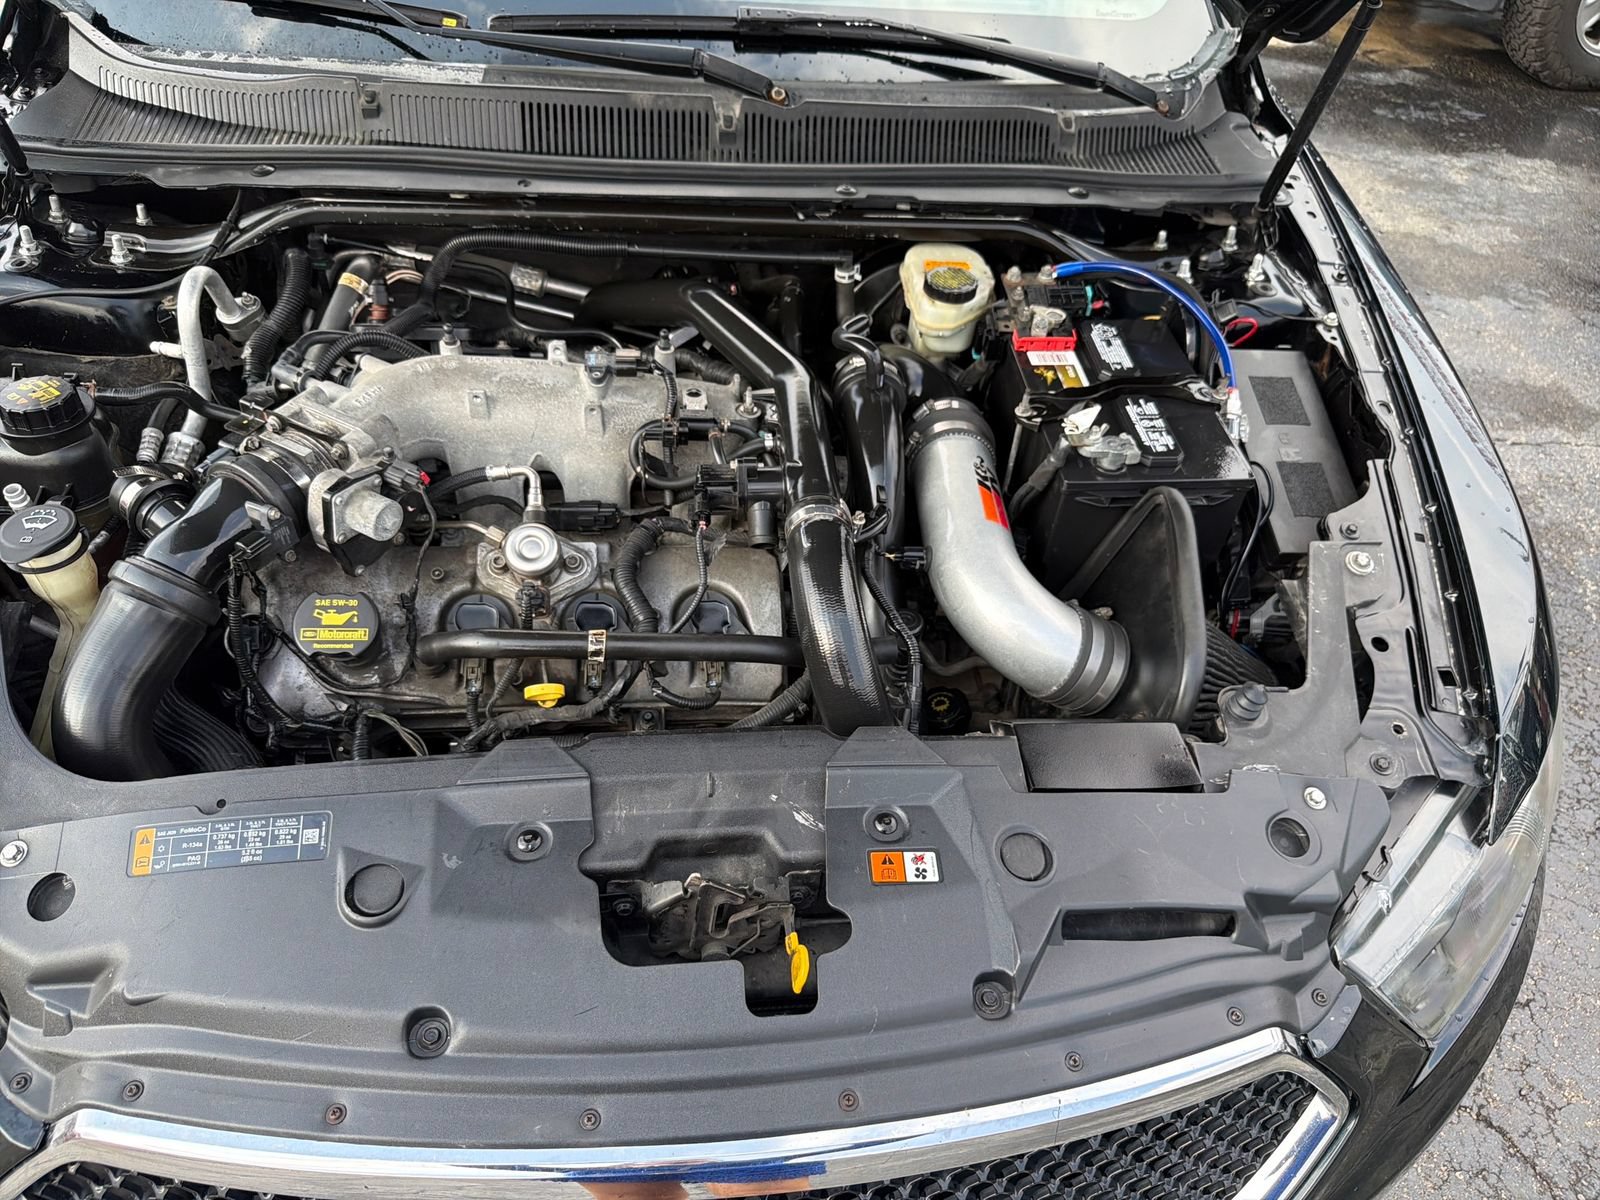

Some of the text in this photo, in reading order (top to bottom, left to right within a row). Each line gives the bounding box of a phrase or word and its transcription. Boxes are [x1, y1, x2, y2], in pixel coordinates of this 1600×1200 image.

[314, 599, 359, 607] SAE 5W-30
[179, 826, 207, 834] FoMoCo
[182, 841, 203, 849] R-134a
